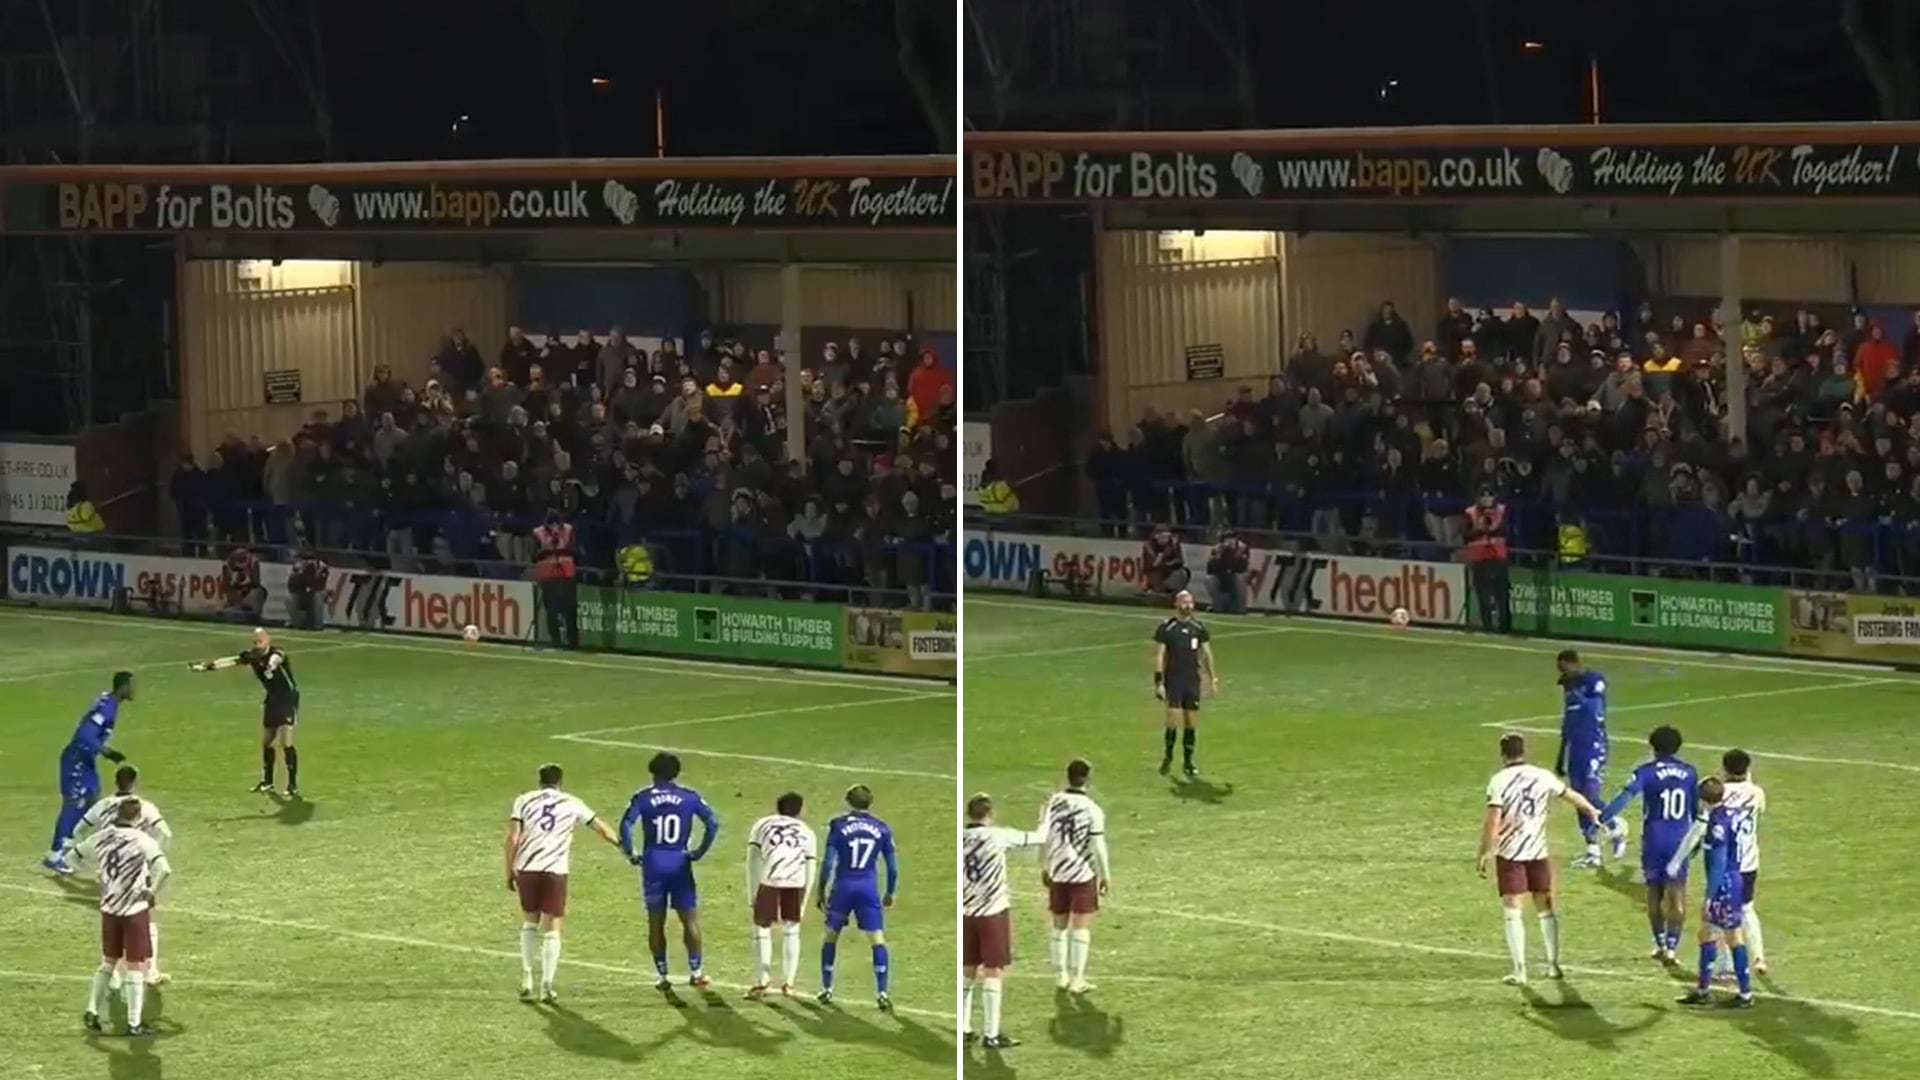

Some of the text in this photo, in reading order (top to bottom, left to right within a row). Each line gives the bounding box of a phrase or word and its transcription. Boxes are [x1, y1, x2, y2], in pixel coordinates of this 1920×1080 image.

[971, 152, 1218, 197] BAPP for Bolts
[1277, 147, 1523, 195] www.bapp.co.uk
[1590, 144, 1899, 195] Holding the UK Together!
[59, 184, 295, 229] BAPP for Bolts
[353, 180, 590, 226] www.bapp.co.uk
[654, 177, 953, 226] Holding the UK Together!
[11, 553, 125, 599] CROWN
[963, 537, 1041, 582] OWN
[1330, 558, 1451, 620] health
[1570, 588, 1614, 606] TIMBER
[404, 578, 521, 636] health
[636, 606, 678, 623] TIMBER
[722, 612, 833, 635] HOWARTH TIMBER
[1659, 595, 1775, 619] HOWARTH TIMBER
[1670, 612, 1720, 630] BUILDING
[1722, 616, 1776, 635] SUPPLIES
[732, 629, 780, 646] BUILDING
[782, 633, 833, 650] SUPPLIES
[539, 804, 556, 832] 5
[1659, 788, 1686, 821] 10
[651, 813, 682, 845] 10
[106, 848, 120, 882] 8
[848, 837, 876, 870] 17
[965, 852, 981, 883] 8
